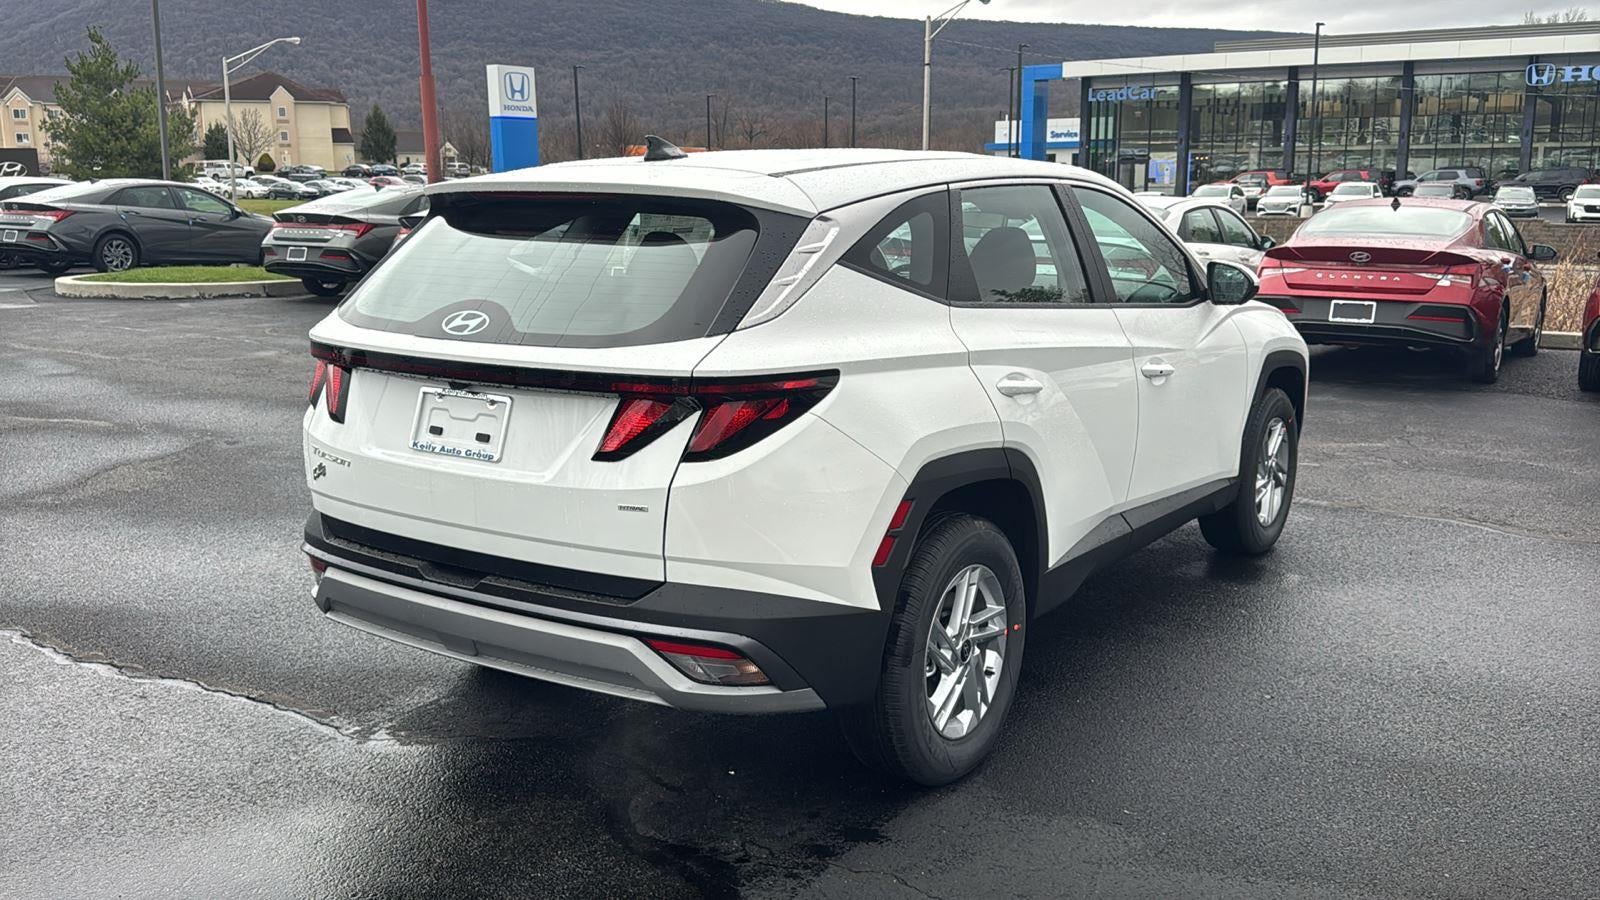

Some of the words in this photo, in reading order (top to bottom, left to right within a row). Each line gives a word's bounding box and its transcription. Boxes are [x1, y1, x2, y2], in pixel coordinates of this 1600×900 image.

[1088, 86, 1156, 101] LeadCar
[504, 104, 534, 112] HONDA
[1050, 130, 1078, 138] Service
[1315, 272, 1401, 281] ELANTRA
[439, 445, 462, 455] Auto
[464, 448, 495, 461] Group
